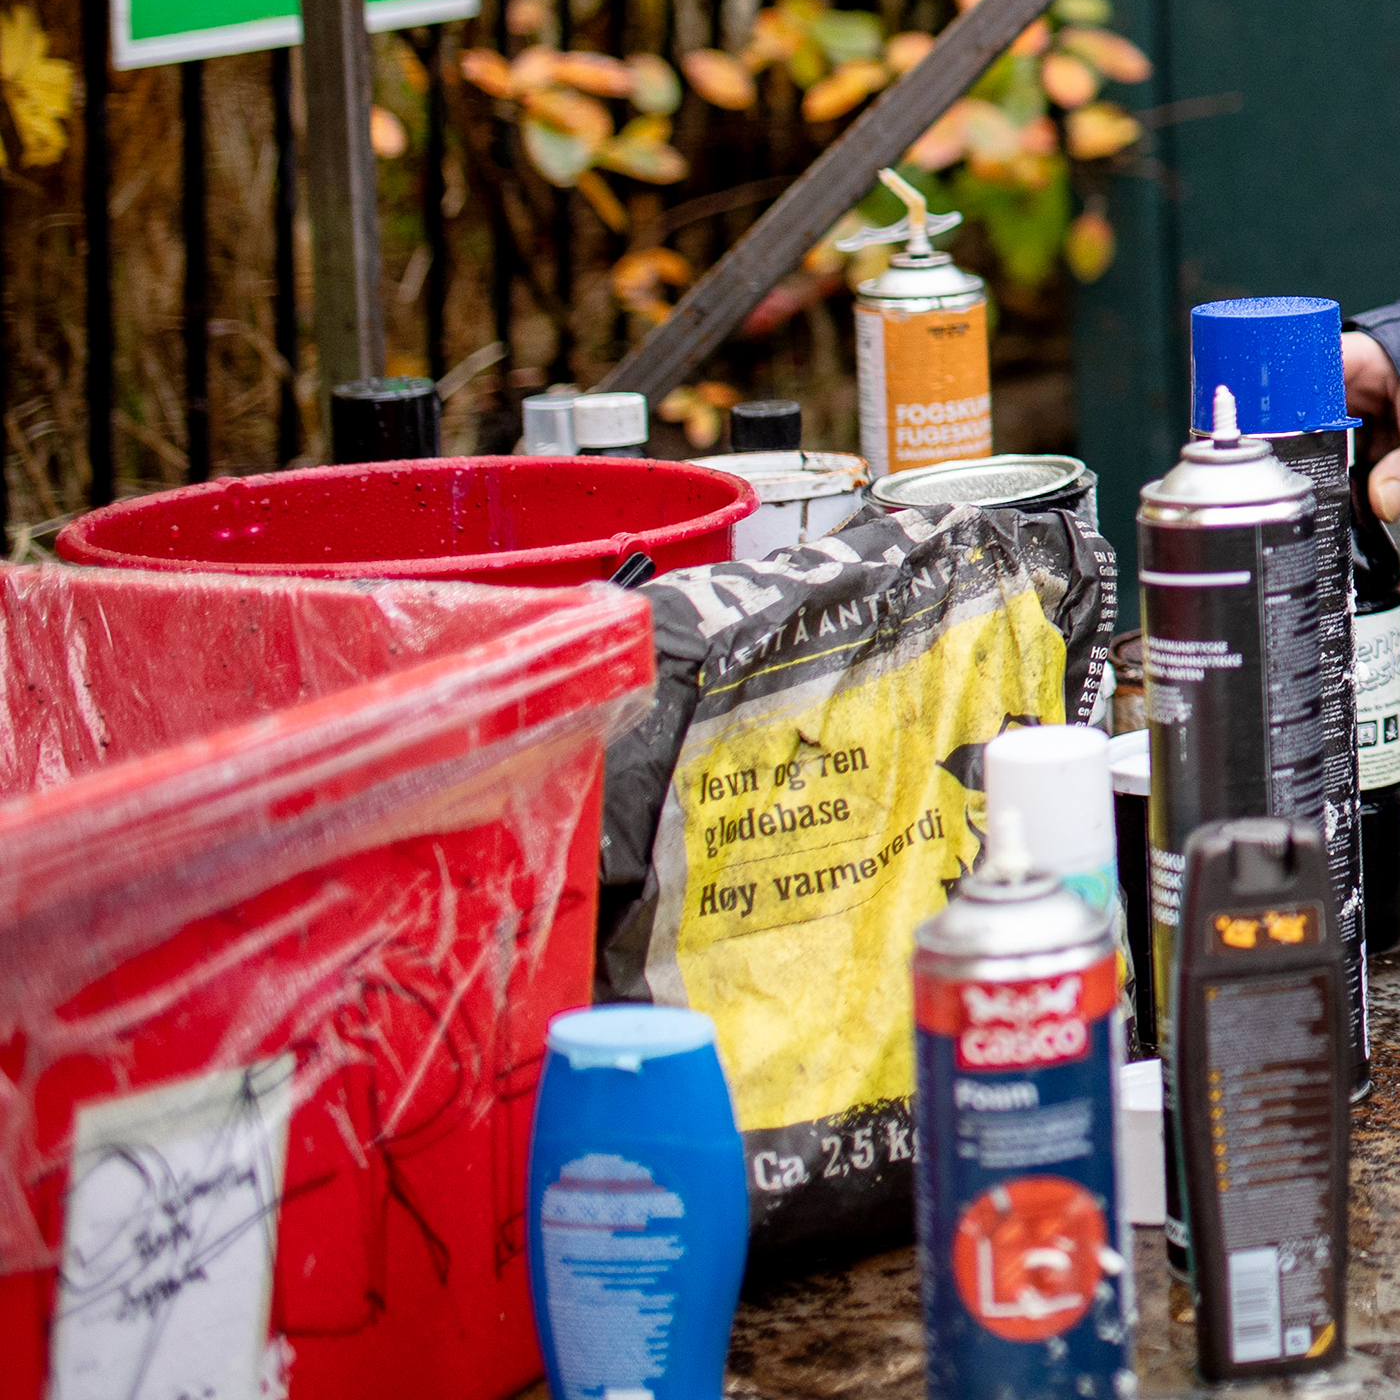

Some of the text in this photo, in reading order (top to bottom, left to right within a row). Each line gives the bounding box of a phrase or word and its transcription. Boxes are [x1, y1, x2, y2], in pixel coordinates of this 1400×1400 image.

[700, 745, 869, 805] Jevn og ren
[704, 797, 850, 859] glødebase
[699, 808, 945, 918] Høy varmeverdi
[821, 1125, 876, 1180] 2,5
